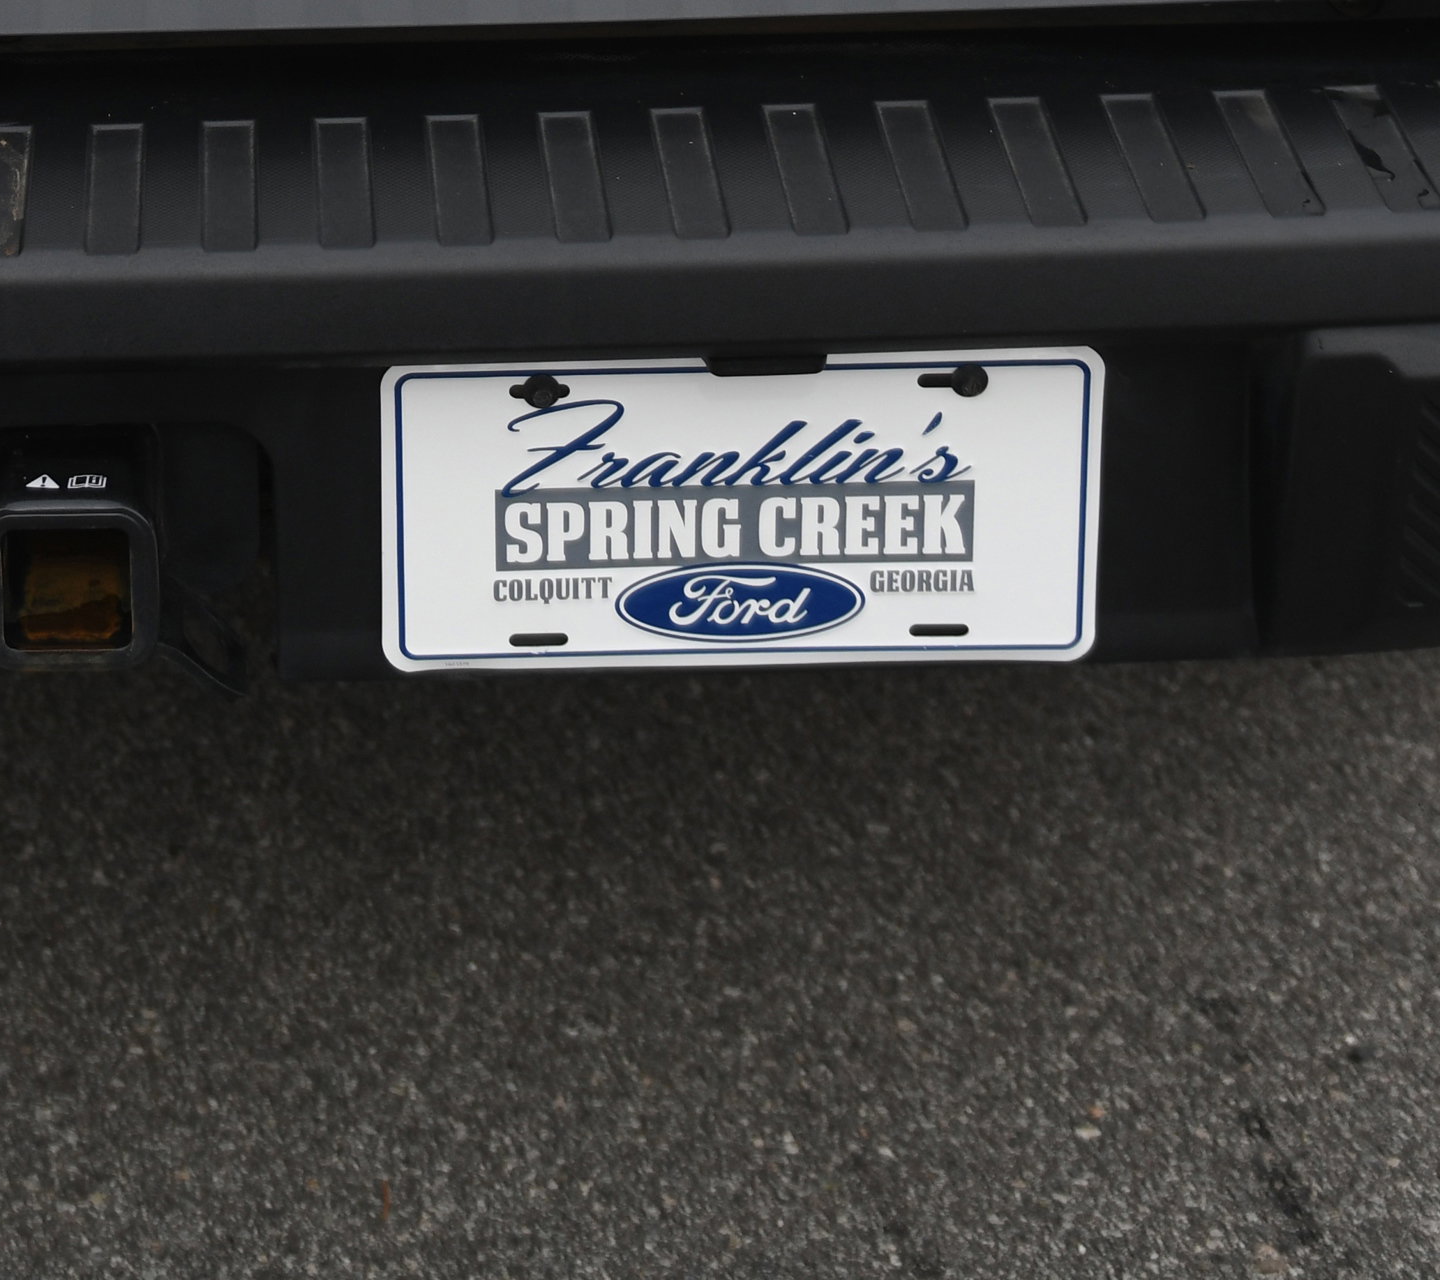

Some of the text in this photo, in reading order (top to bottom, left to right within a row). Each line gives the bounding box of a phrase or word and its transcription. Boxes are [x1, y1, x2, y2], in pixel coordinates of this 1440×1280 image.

[500, 398, 973, 498] Franklin's
[503, 493, 968, 564] SPRING CREEK
[492, 576, 614, 605] COLQUITT
[669, 574, 809, 626] Ford
[868, 568, 976, 594] GEORGIA
